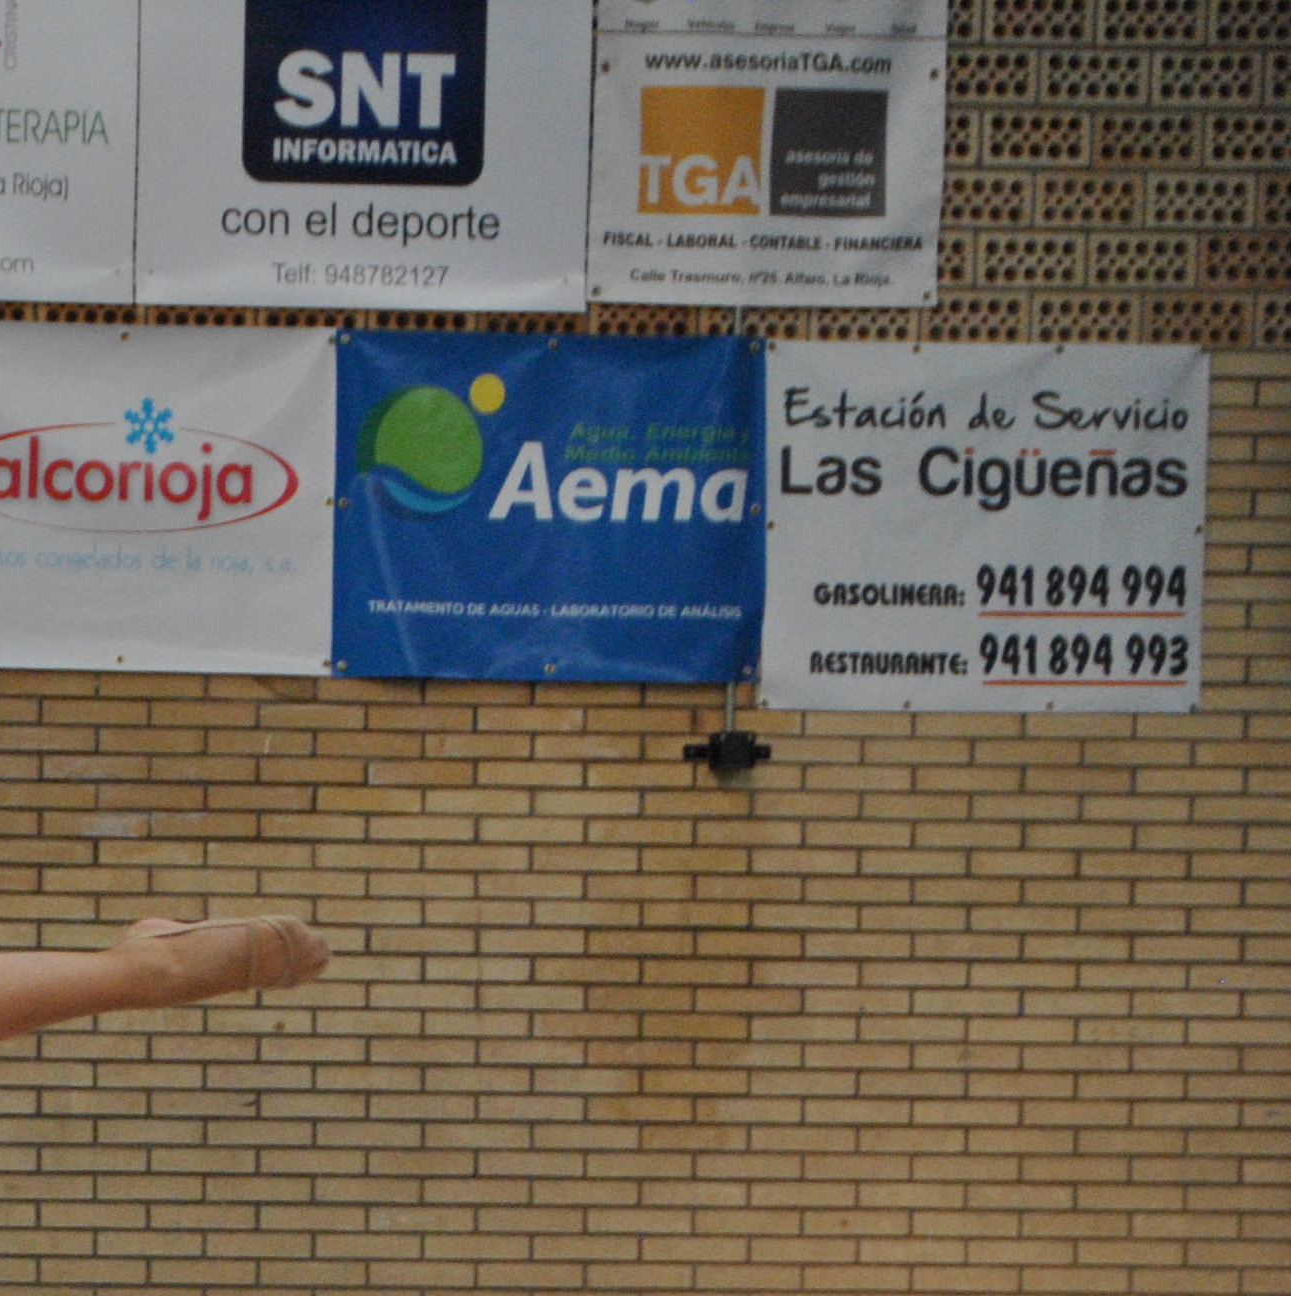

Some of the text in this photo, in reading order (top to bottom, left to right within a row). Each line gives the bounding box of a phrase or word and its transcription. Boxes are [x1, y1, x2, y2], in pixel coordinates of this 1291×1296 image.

[273, 49, 457, 131] SNT
[272, 136, 458, 165] INFORMATICA
[12, 173, 70, 201] Rioja)
[639, 154, 761, 206] TGA
[221, 202, 500, 247] con el deporte
[603, 231, 923, 251] FISCAL LABORAL CONTABLE FINANCIERA
[324, 262, 450, 286] 948782127
[783, 386, 1189, 431] Estación de Servicio
[488, 439, 749, 524] Aema
[779, 445, 1189, 511] Las Cigüeñas
[976, 564, 1034, 608] 941
[1044, 564, 1110, 608] 894
[1121, 564, 1188, 608] 994
[368, 600, 464, 616] TRATAMIENTO
[467, 602, 487, 616] DE
[489, 603, 540, 617] AGUAS
[550, 604, 655, 619] LABORATORIO
[658, 605, 678, 619] DE
[979, 632, 1038, 676] 941
[1048, 632, 1113, 676] 894
[1125, 632, 1189, 676] 993
